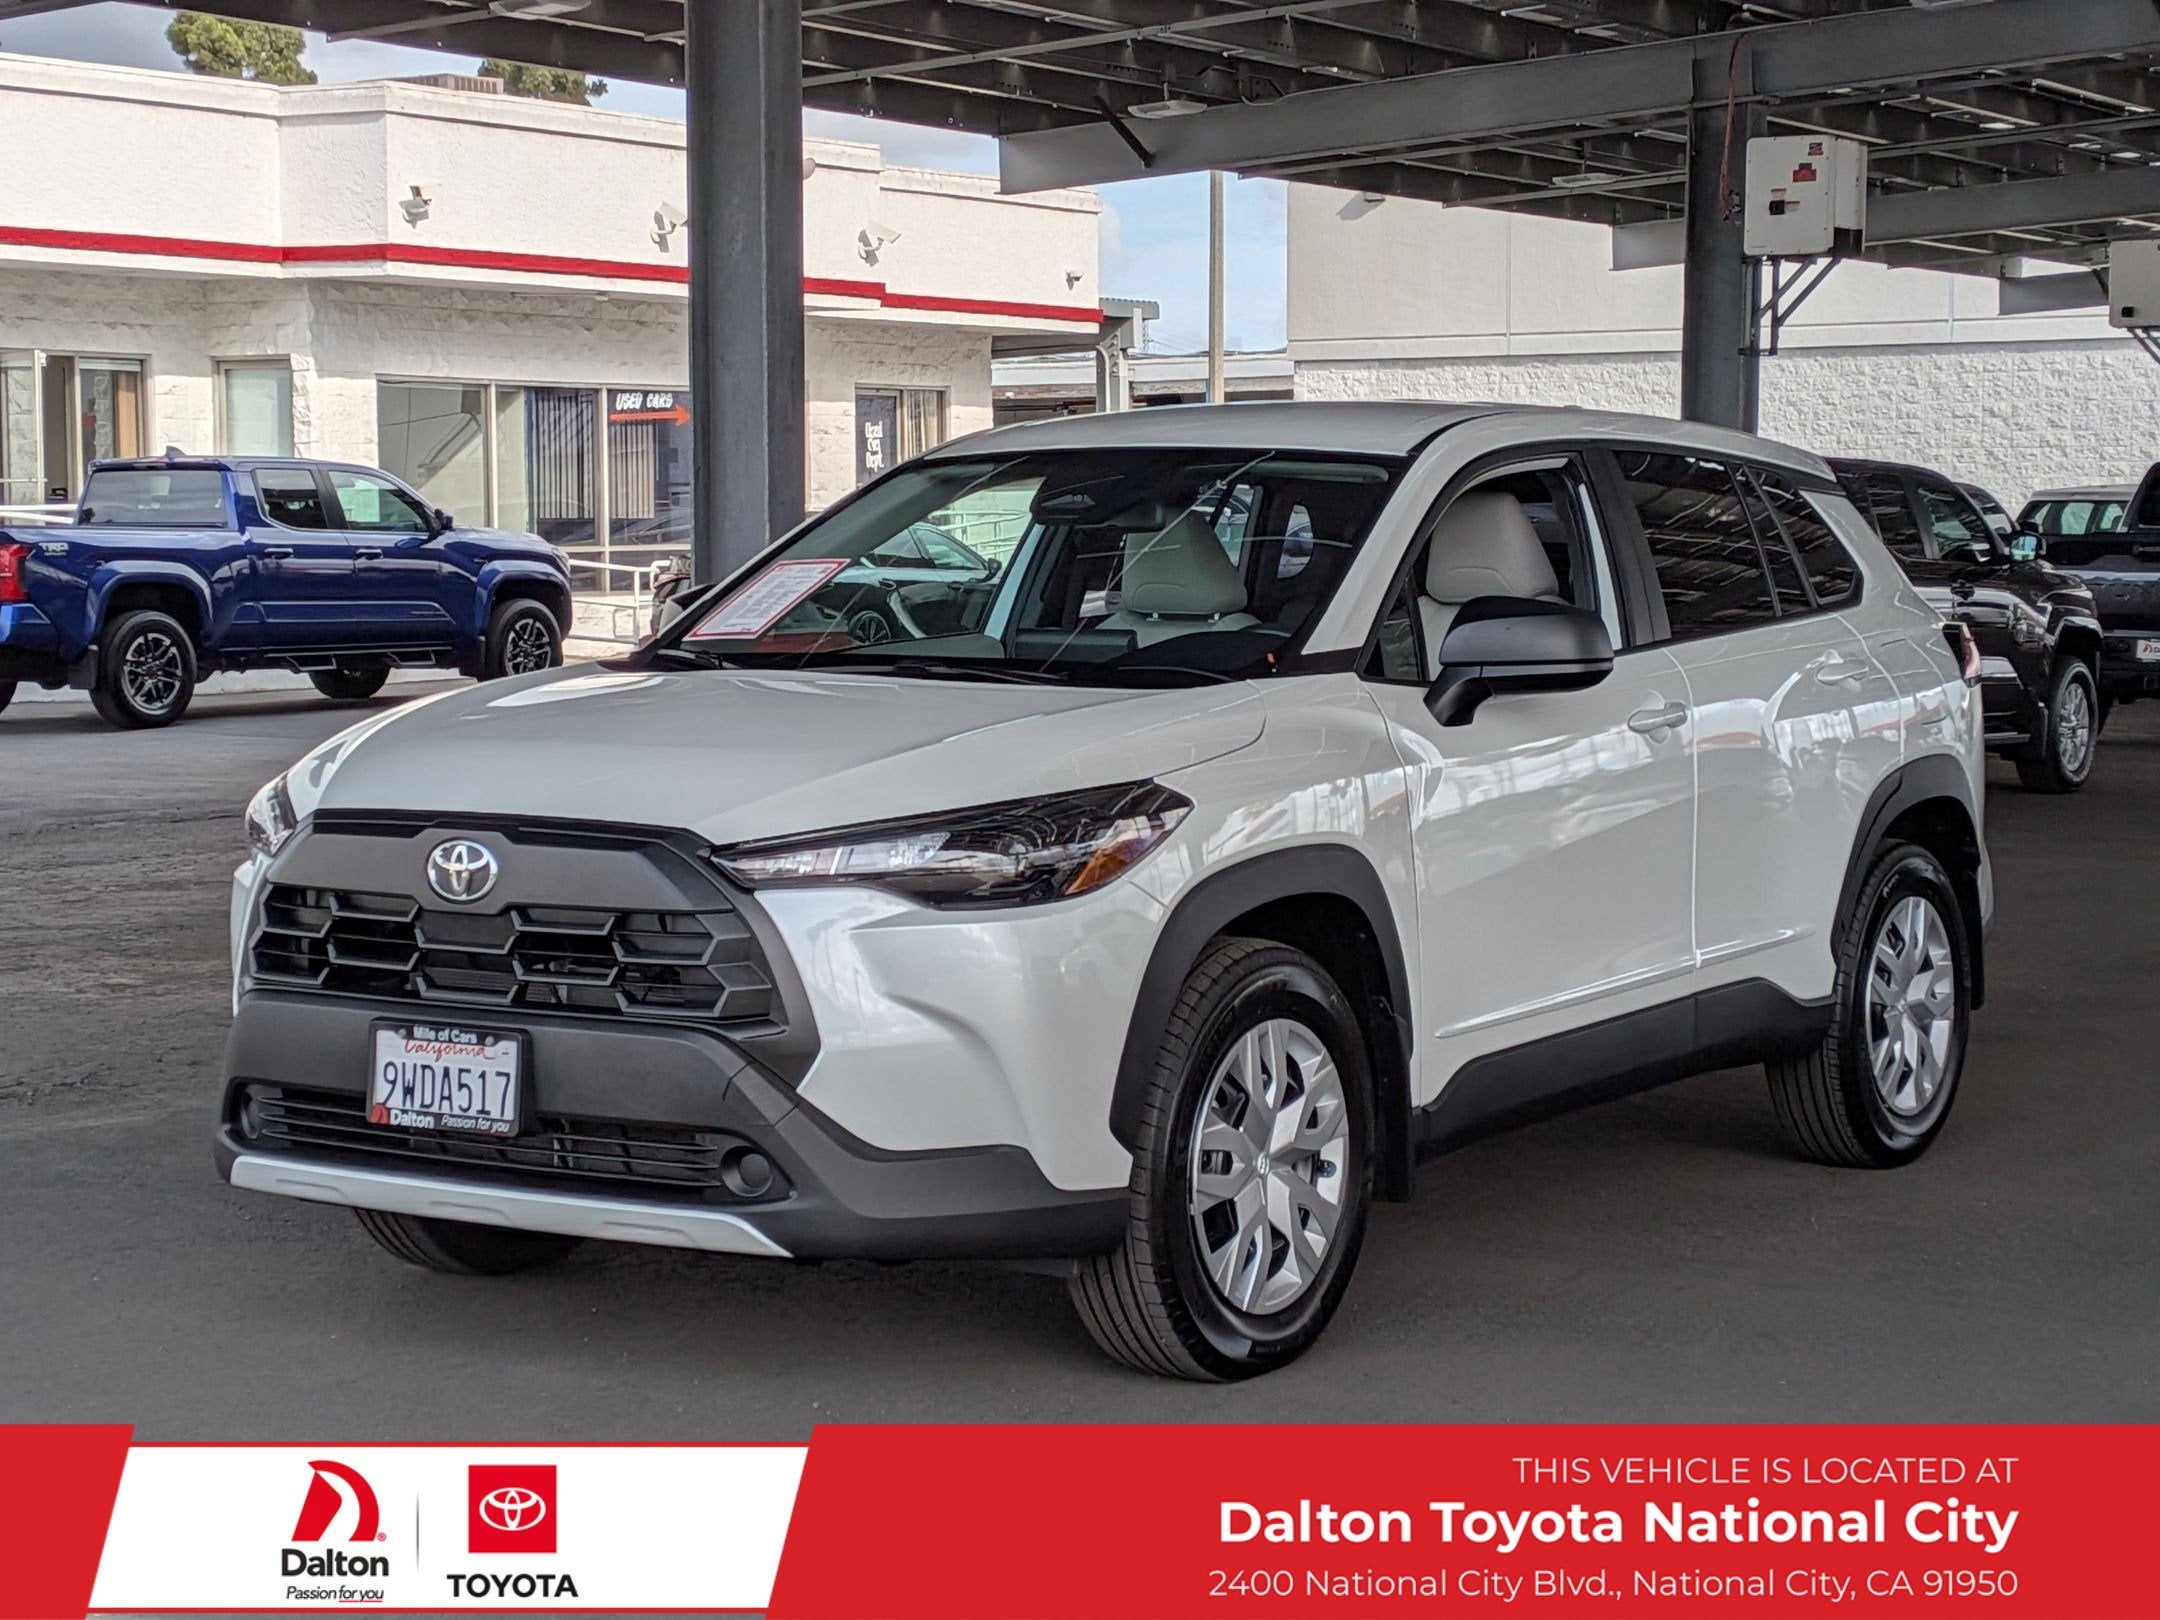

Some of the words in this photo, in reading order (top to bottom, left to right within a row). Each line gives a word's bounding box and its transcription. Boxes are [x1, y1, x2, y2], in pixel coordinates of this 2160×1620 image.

[616, 392, 643, 410] USED
[646, 393, 673, 408] CARS
[437, 1029, 449, 1041] of
[450, 1029, 477, 1044] Cars
[404, 1038, 496, 1063] California
[383, 1061, 511, 1118] 9WDA517
[389, 1109, 434, 1129] Dalton
[440, 1115, 476, 1130] Passion
[476, 1116, 491, 1131] for
[490, 1121, 510, 1134] you
